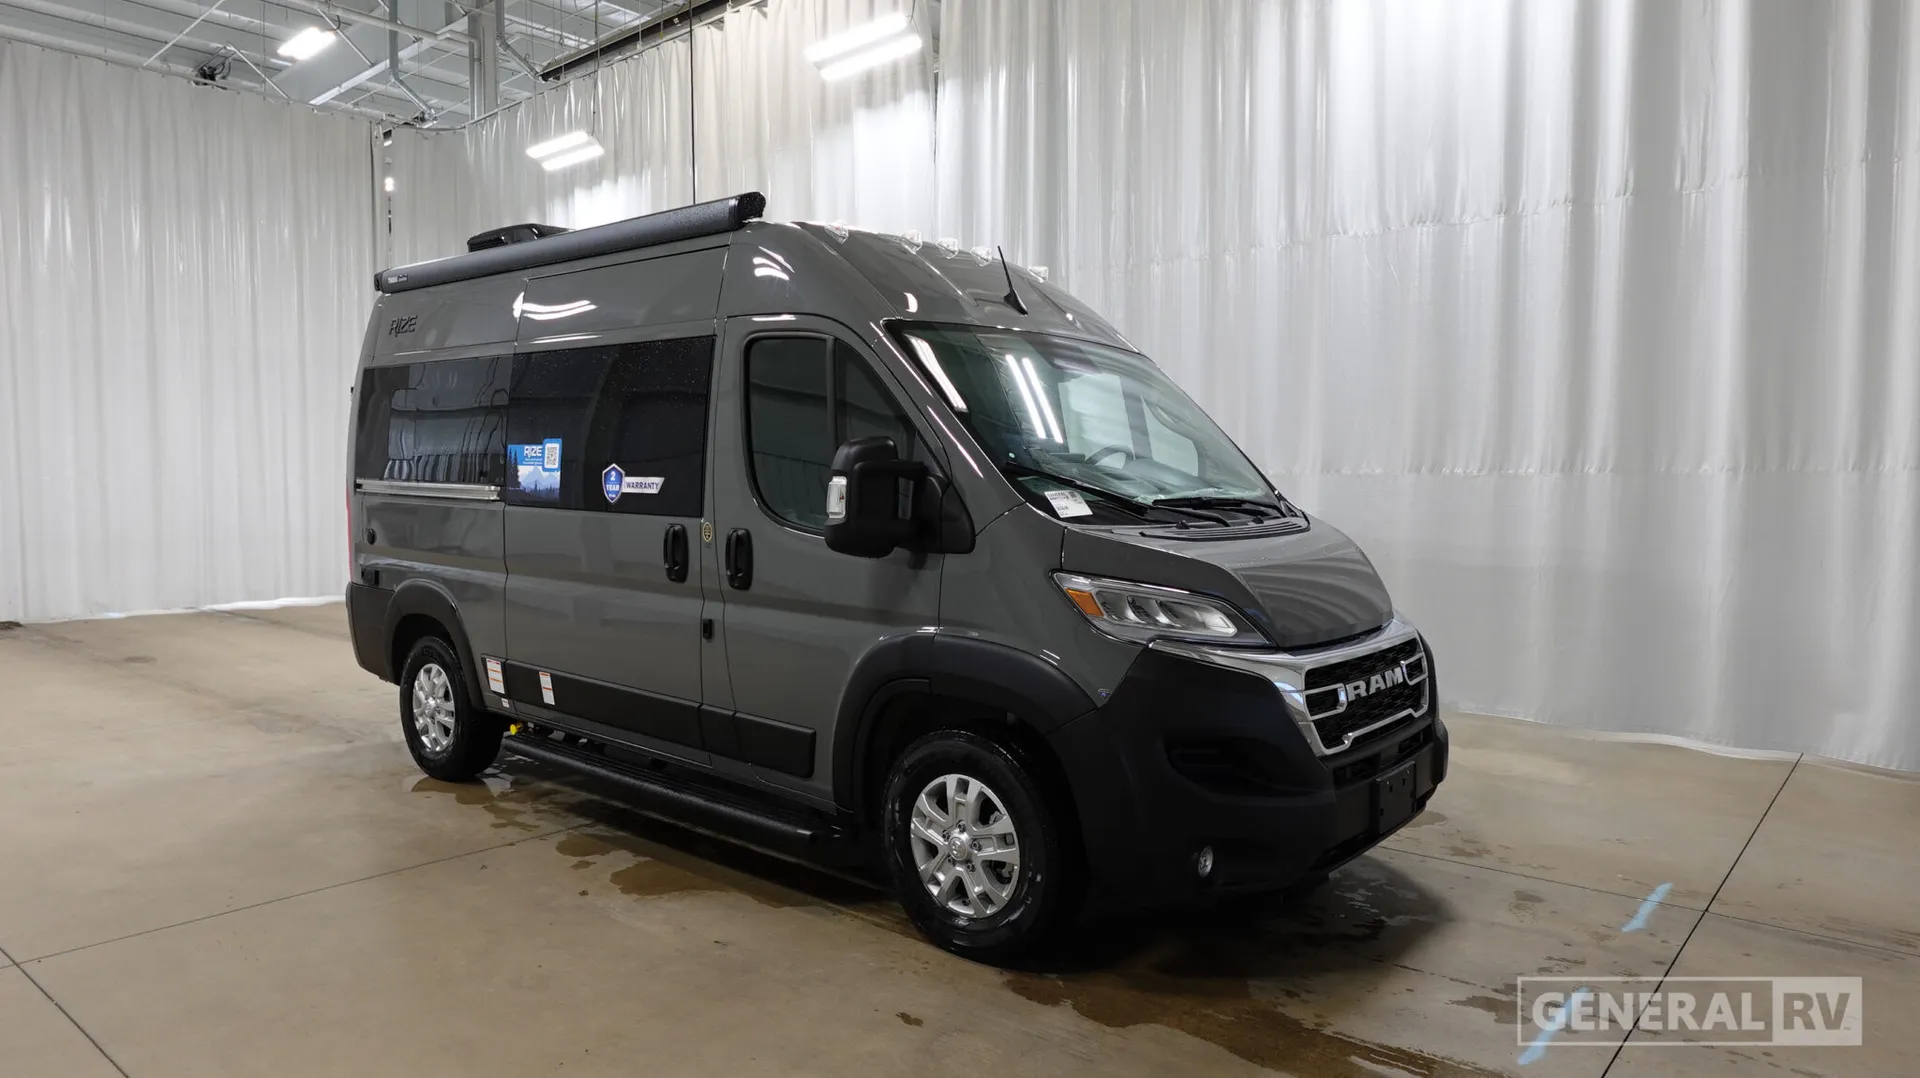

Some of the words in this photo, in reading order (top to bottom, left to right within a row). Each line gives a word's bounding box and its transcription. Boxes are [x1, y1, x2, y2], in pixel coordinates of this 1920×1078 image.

[388, 315, 418, 338] RIZE
[524, 445, 543, 457] RIZE
[610, 470, 616, 481] 2
[626, 481, 660, 490] WARRANTY
[1345, 666, 1404, 702] RAM
